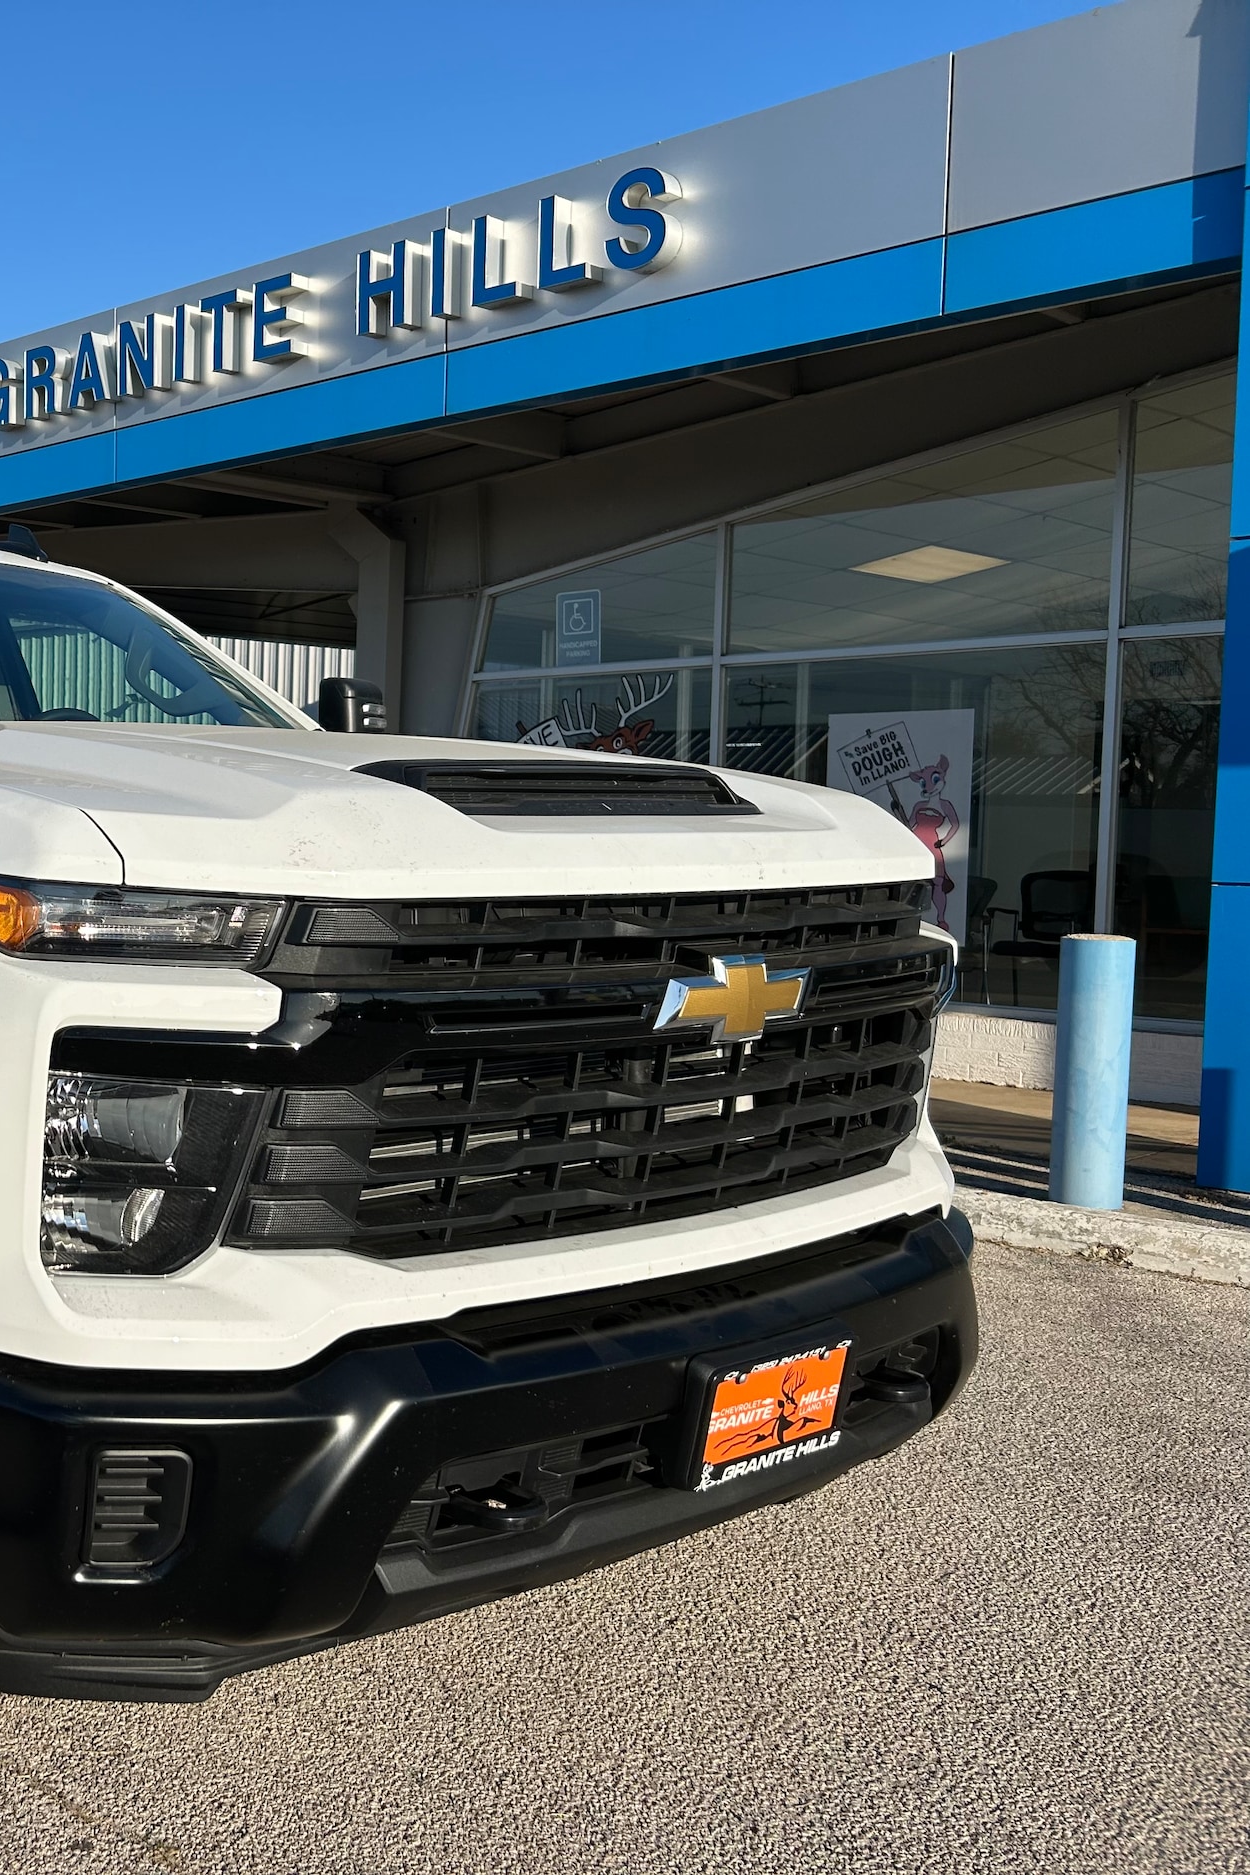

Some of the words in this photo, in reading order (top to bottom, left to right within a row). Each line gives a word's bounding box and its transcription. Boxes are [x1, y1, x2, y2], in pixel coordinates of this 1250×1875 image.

[356, 166, 676, 338] HILLS
[559, 640, 598, 649] HANDICAPPED
[565, 649, 591, 657] PARKING
[854, 740, 879, 757] Save
[879, 730, 897, 746] BIG
[851, 740, 906, 777] DOUGH
[871, 756, 911, 782] LLANO!
[798, 1402, 822, 1416] LLANO,
[824, 1397, 834, 1407] TX
[799, 1383, 840, 1407] HILLS
[720, 1399, 762, 1417] CHEVROLET
[721, 1444, 798, 1482] GRANITE
[795, 1430, 841, 1457] HILLS
